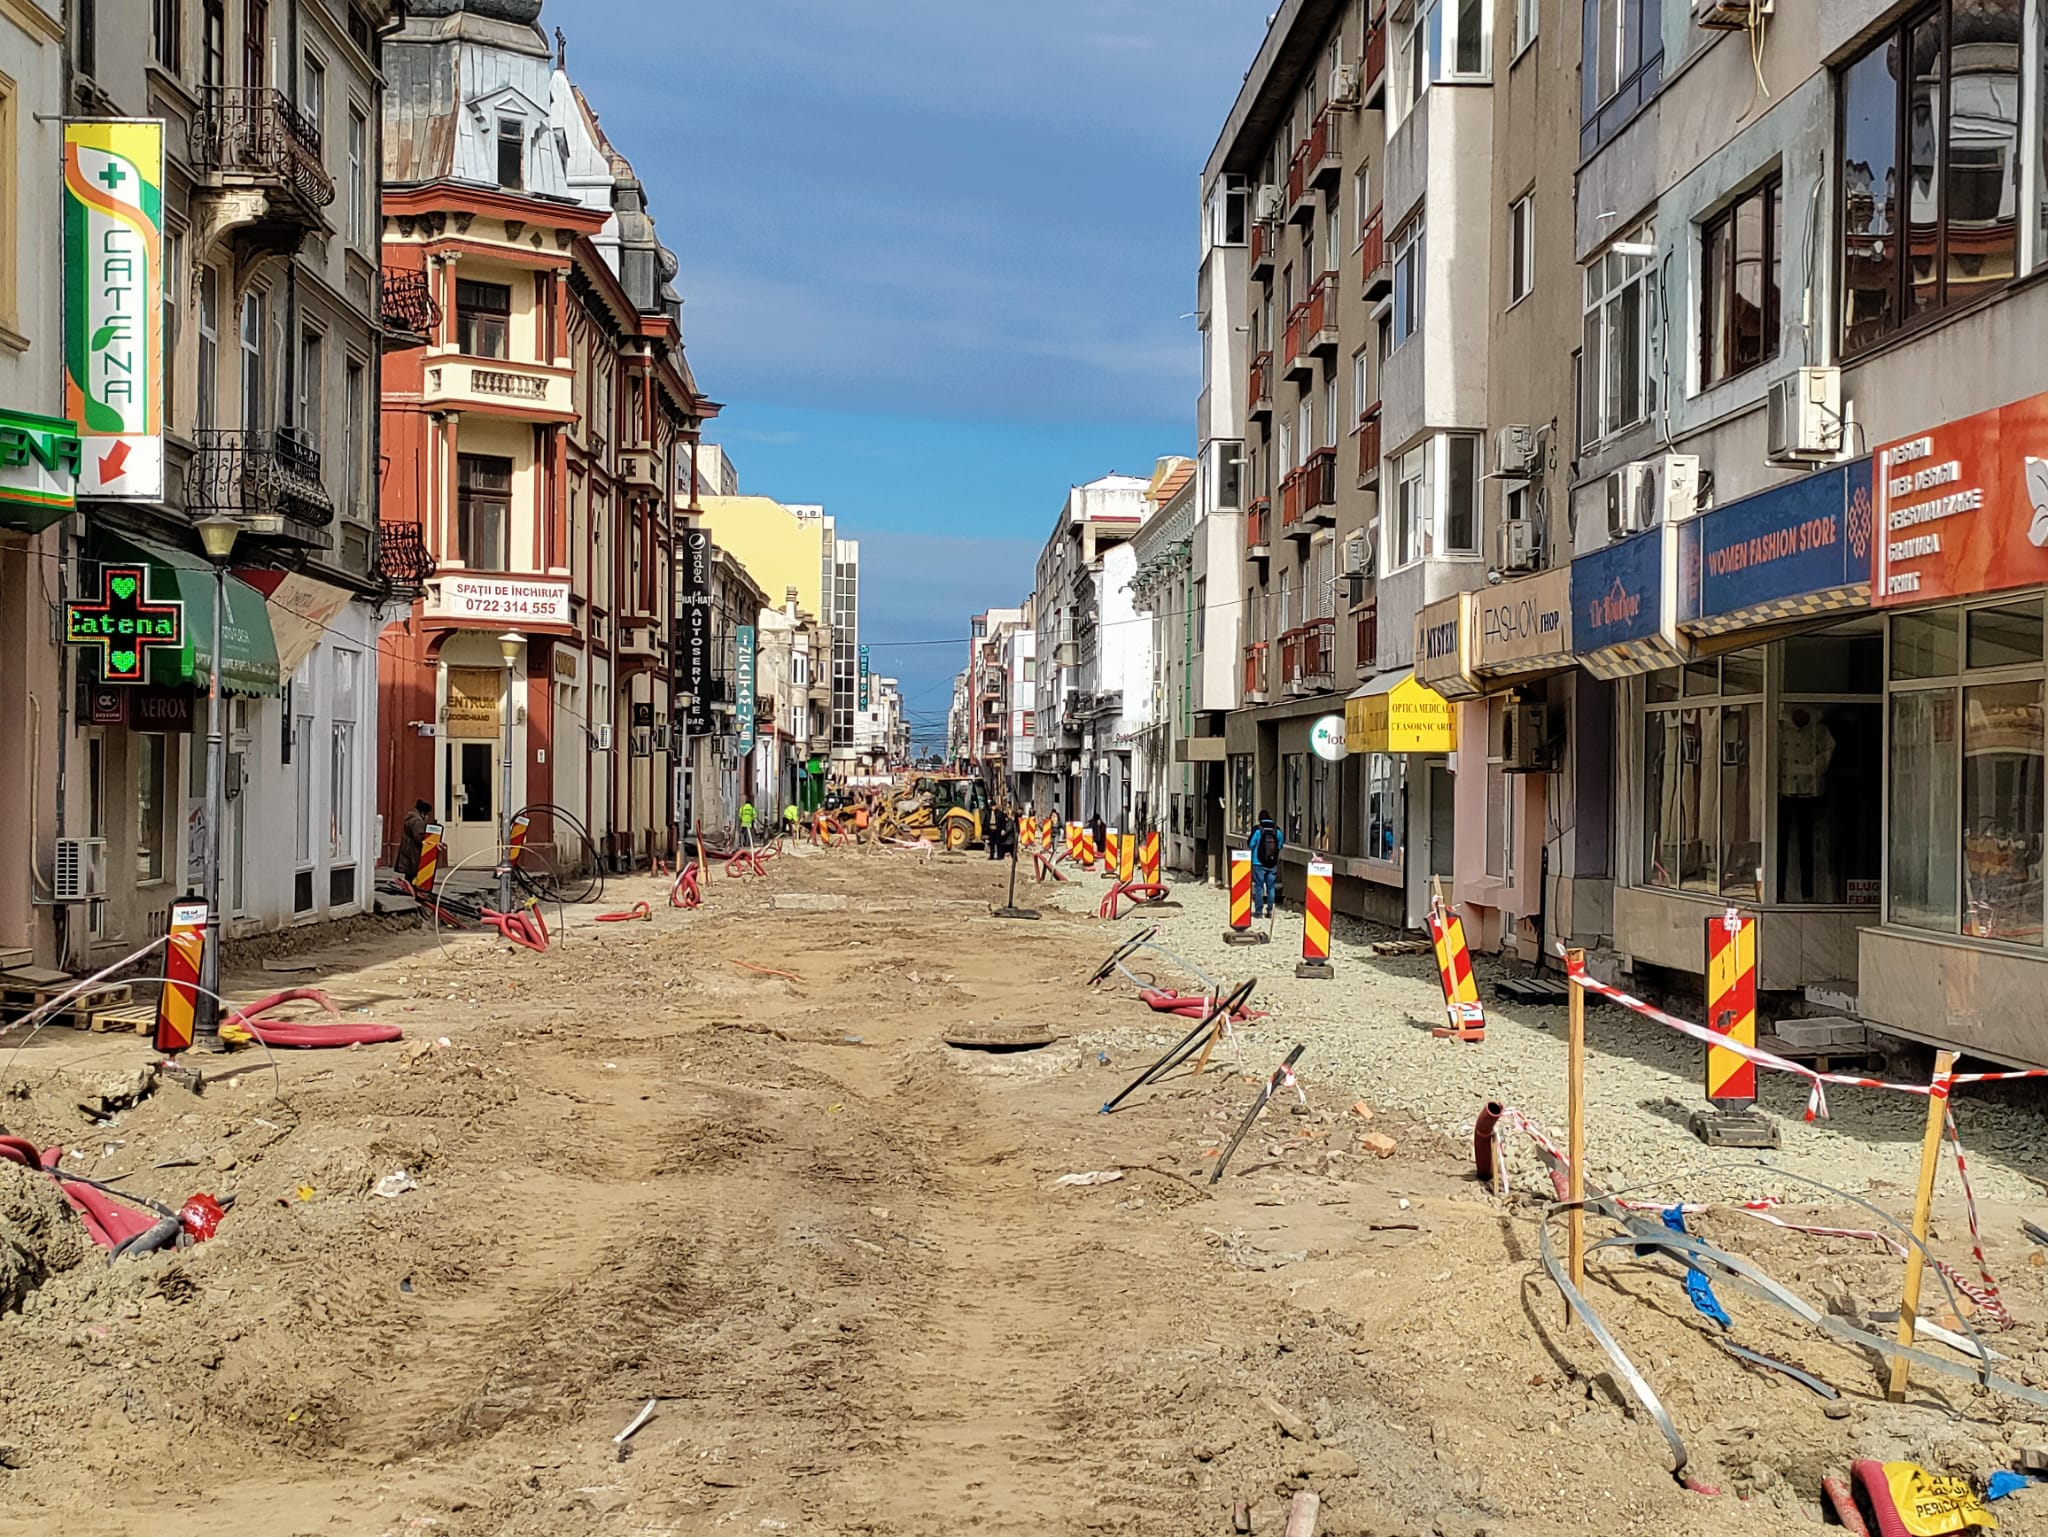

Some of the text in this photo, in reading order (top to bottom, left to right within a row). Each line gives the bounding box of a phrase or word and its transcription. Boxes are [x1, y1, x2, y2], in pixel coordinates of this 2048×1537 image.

[96, 229, 132, 404] CATENA
[1889, 436, 1934, 466] DESIGN
[1889, 460, 1961, 498] WEB DESIGN
[1889, 488, 1984, 531] PERSONALIZARE
[1708, 543, 1748, 577] WOMEN
[1750, 527, 1797, 566] FASHION
[1800, 514, 1836, 552] STORE
[692, 550, 704, 584] pepsi
[1888, 571, 1921, 595] PRINT
[466, 598, 556, 615] 0722 314 555
[495, 586, 509, 596] DE
[511, 585, 565, 598] ÎNCHIRIAT
[1485, 598, 1560, 645] FASHION SHOP
[1426, 620, 1458, 660] MYSTERY
[690, 608, 703, 714] AUTOSERVIRE
[140, 698, 187, 718] XEROX
[1392, 703, 1455, 713] OPTICA MEDICALA
